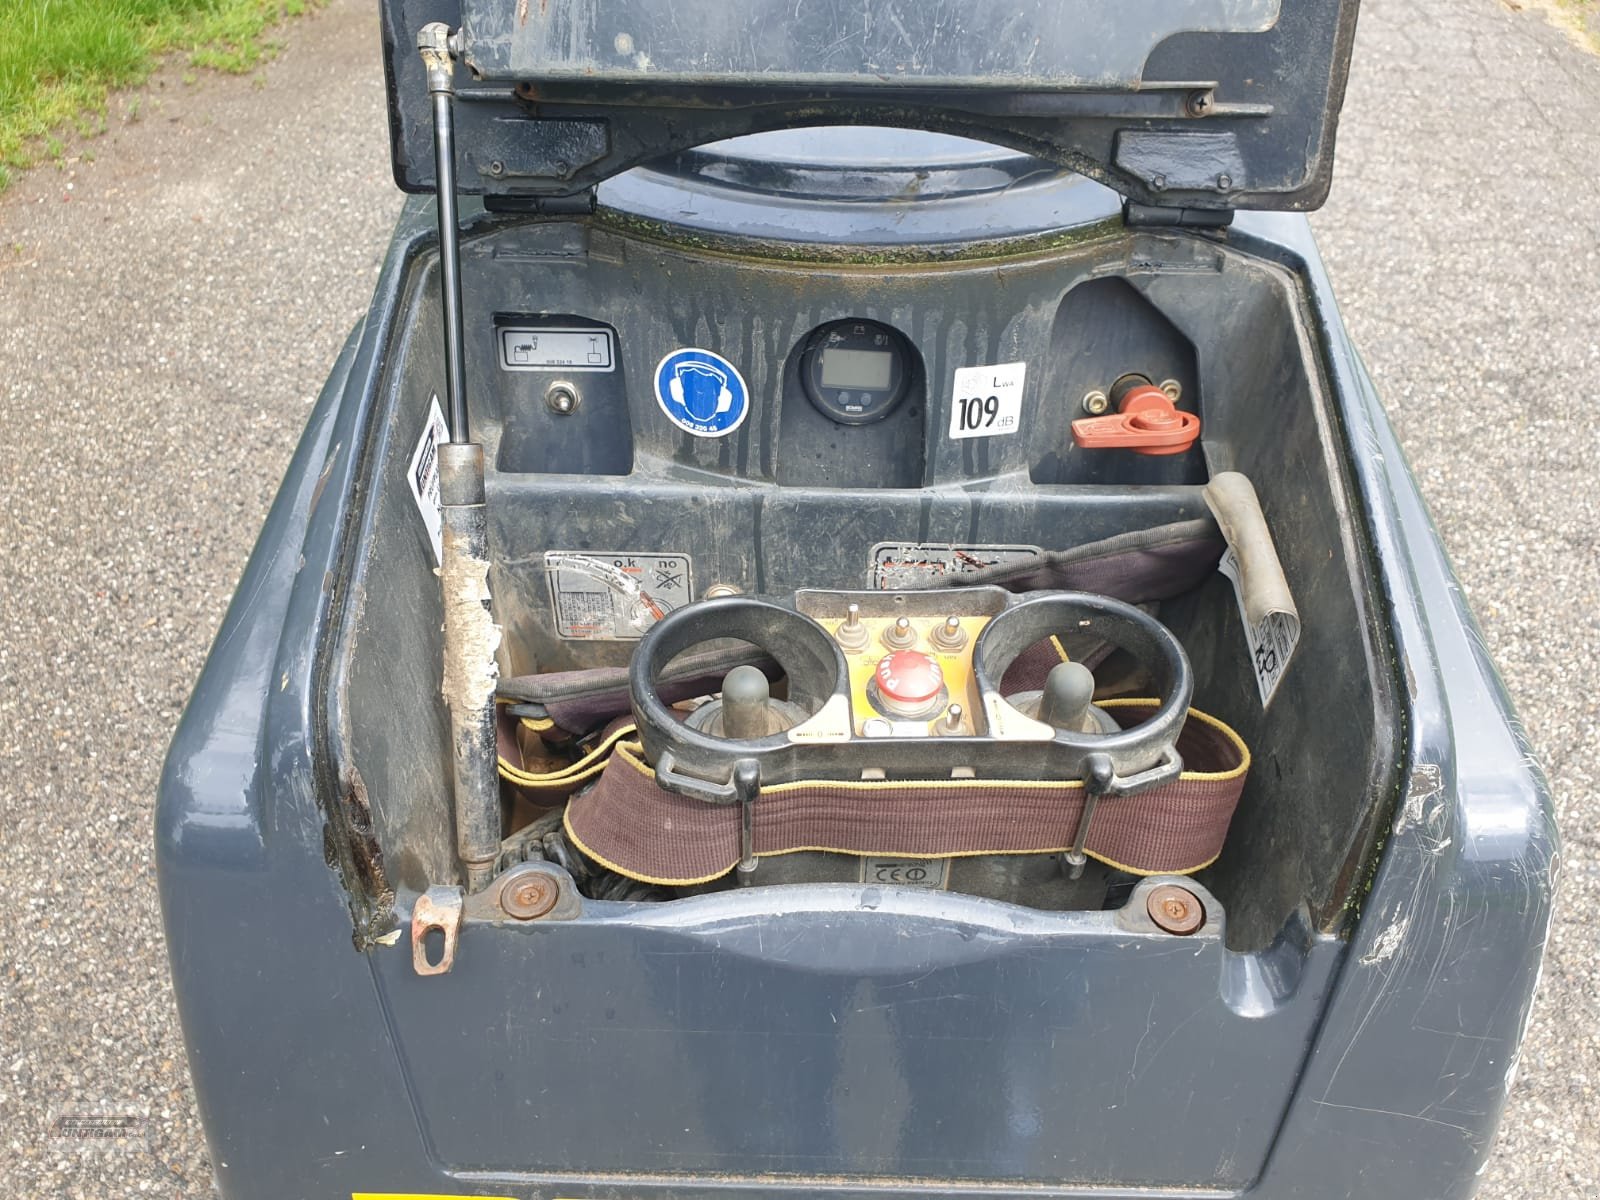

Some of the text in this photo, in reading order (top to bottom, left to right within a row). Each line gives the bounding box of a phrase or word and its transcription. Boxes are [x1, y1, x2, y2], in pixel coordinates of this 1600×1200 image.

[959, 395, 999, 431] 109
[997, 416, 1014, 427] dB
[658, 560, 678, 569] no
